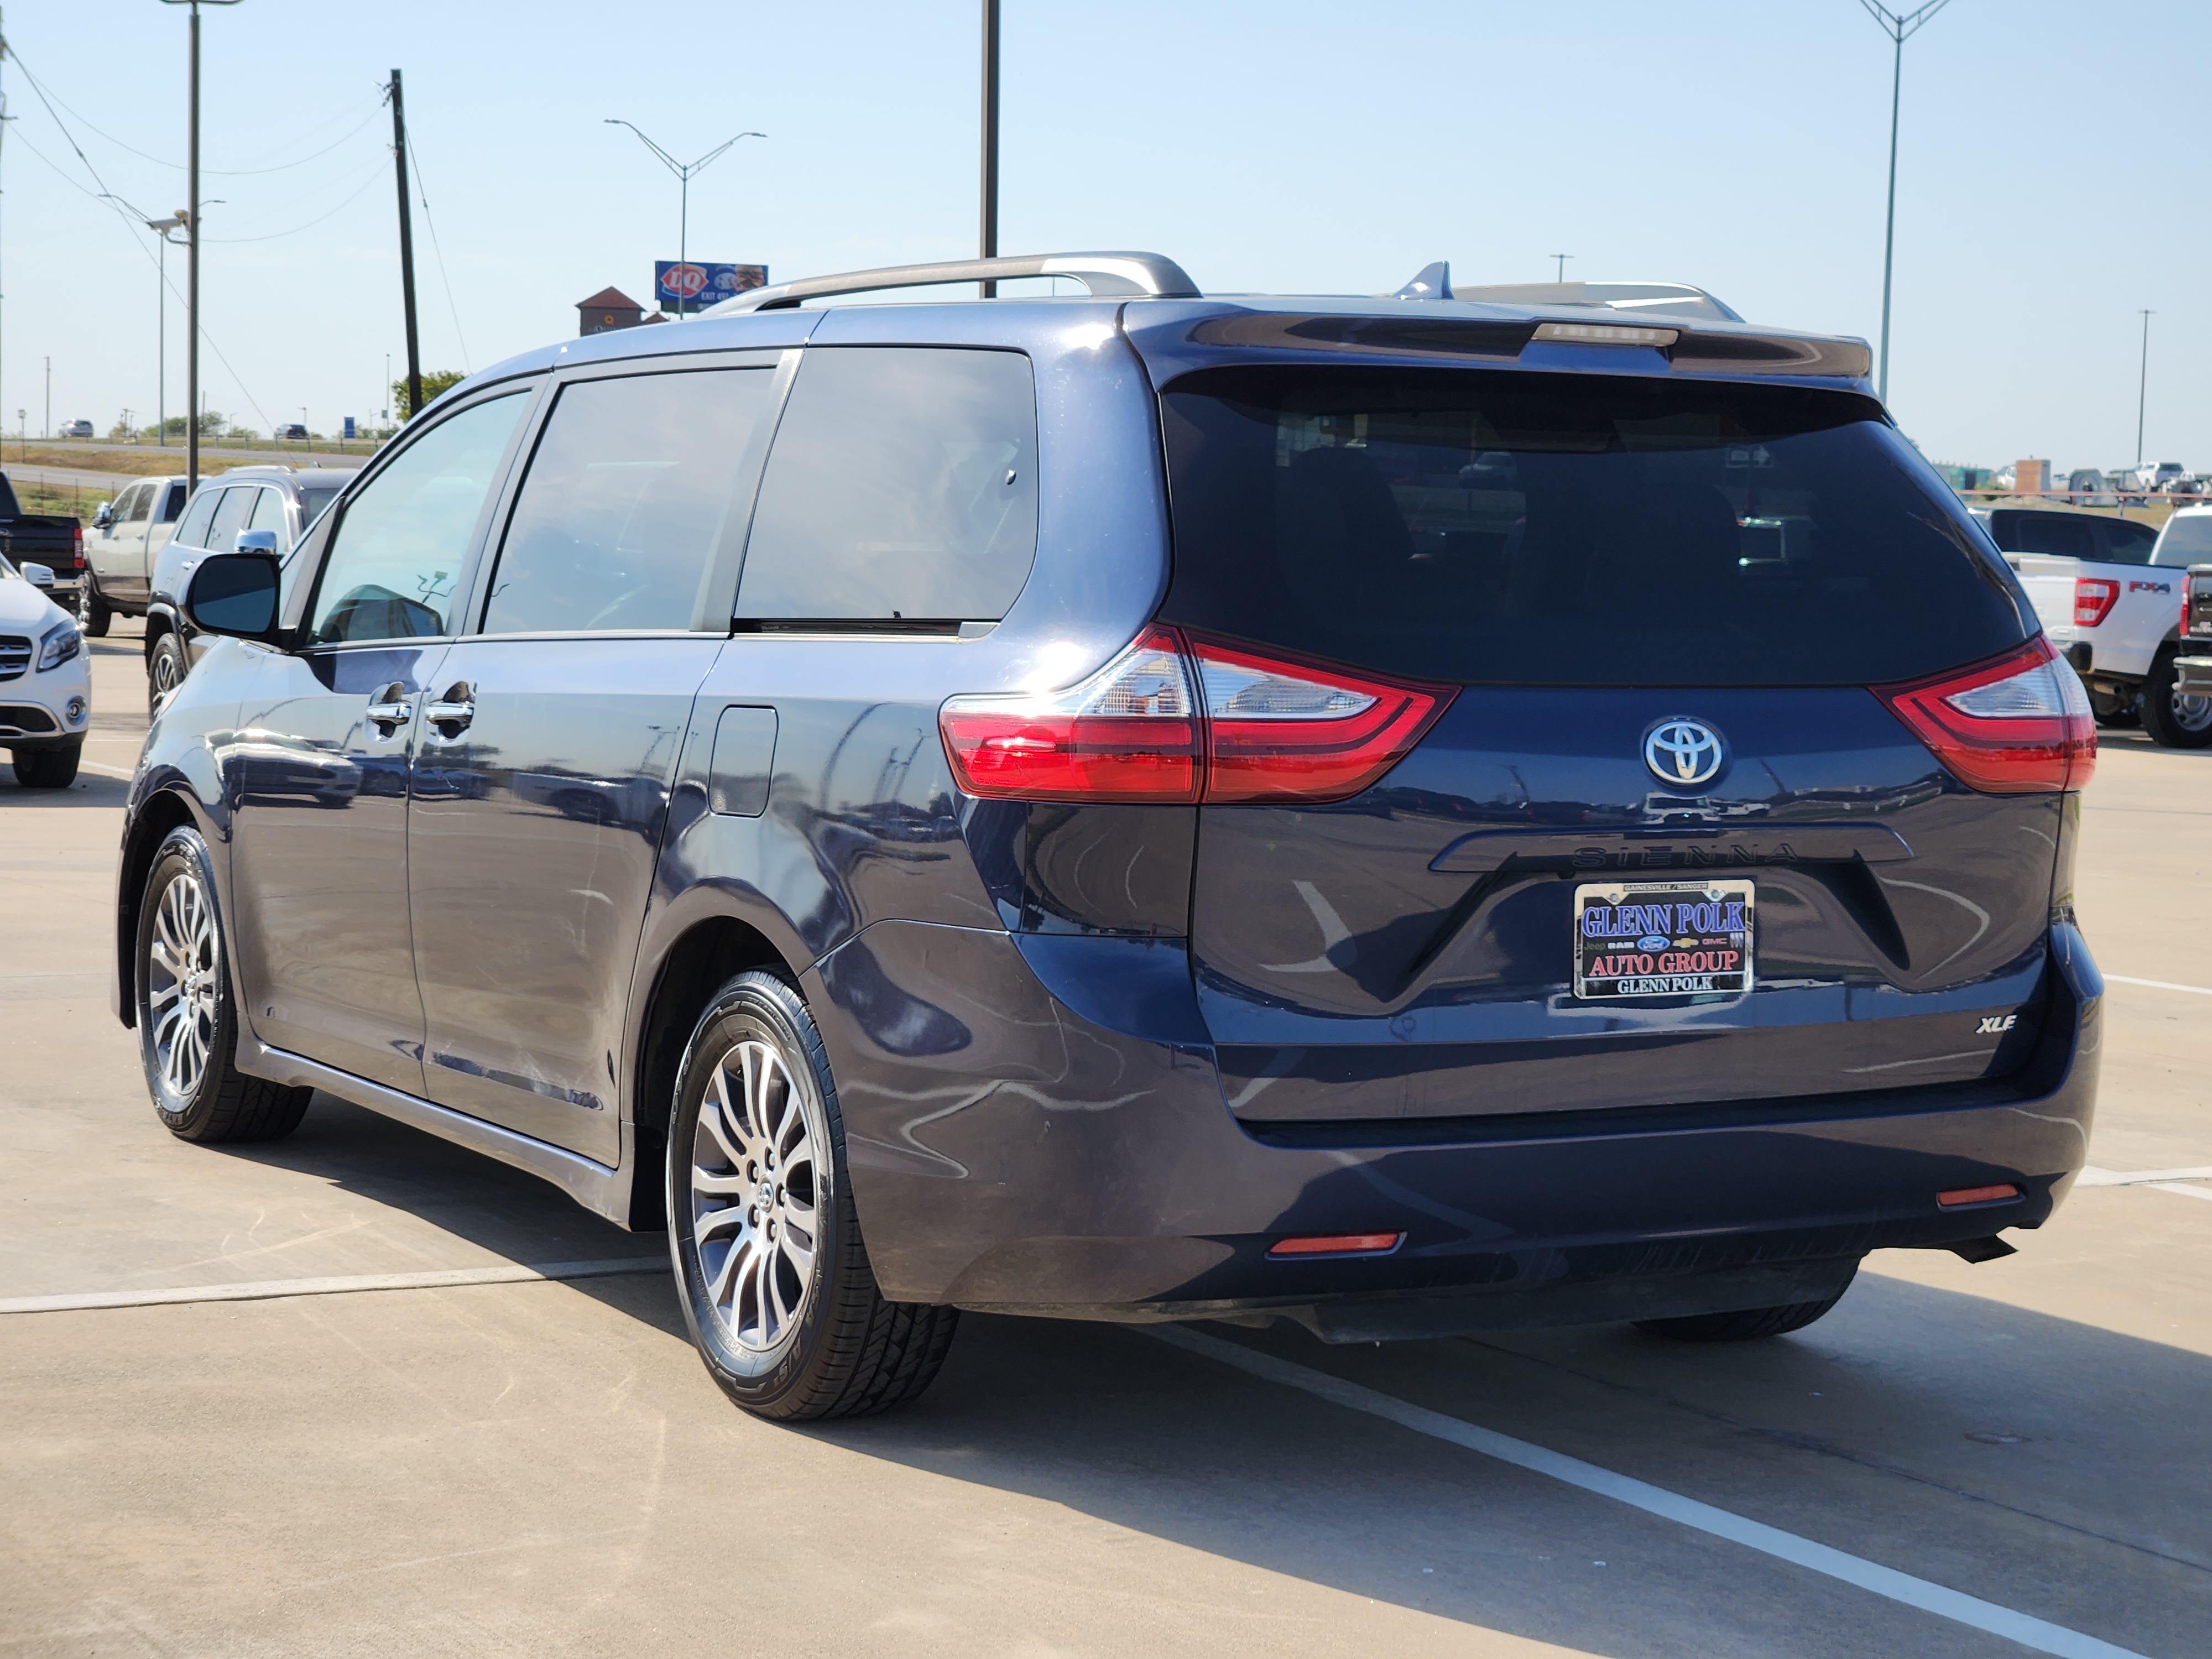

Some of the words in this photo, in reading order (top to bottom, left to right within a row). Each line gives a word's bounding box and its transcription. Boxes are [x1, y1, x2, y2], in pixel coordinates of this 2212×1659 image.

[670, 270, 702, 294] DQ
[702, 292, 714, 300] EXIT
[2128, 581, 2171, 593] FX4
[1572, 842, 1797, 867] SIENNA
[1583, 905, 1673, 937] GLENN
[1676, 902, 1745, 933] POLK
[1584, 942, 1605, 952] Jeep
[1589, 954, 1653, 977] AUTO
[1658, 951, 1739, 973] GROUP
[1617, 978, 1671, 994] GLENN
[1672, 976, 1714, 992] POLK
[1975, 1015, 2017, 1034] XLE
